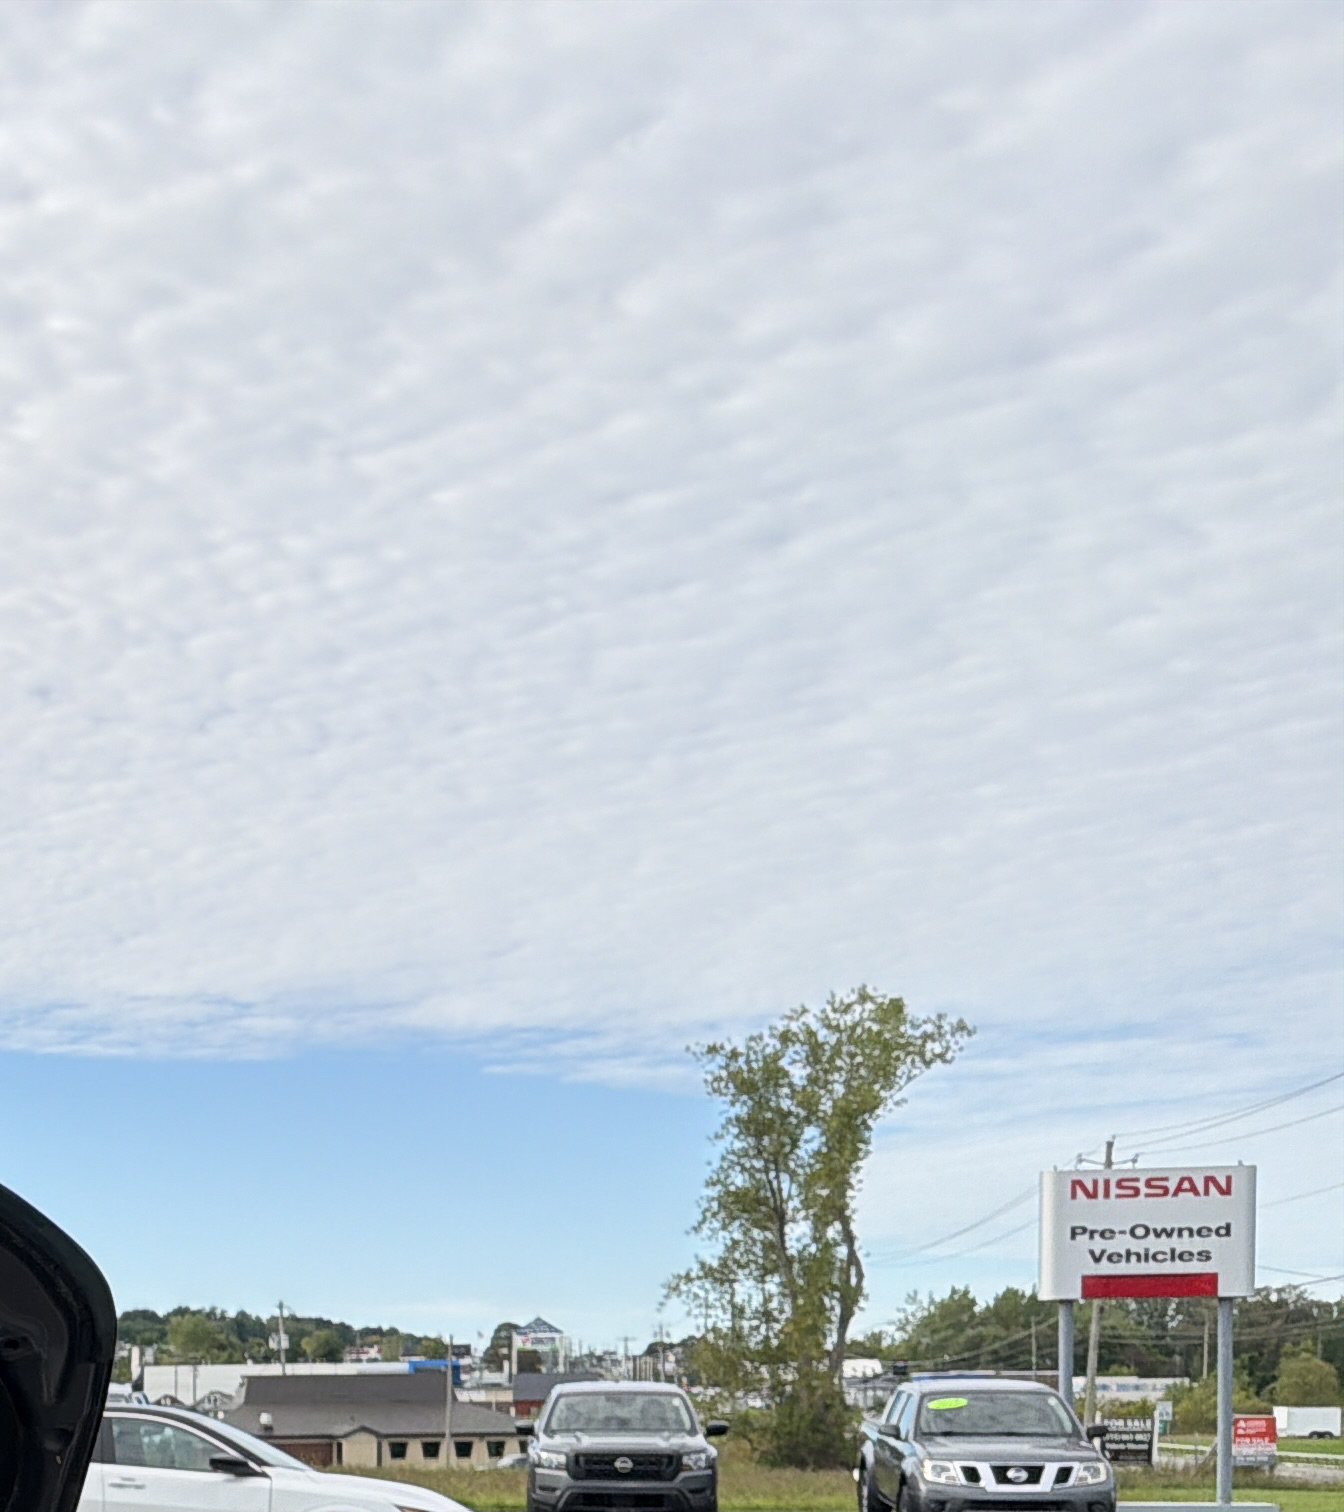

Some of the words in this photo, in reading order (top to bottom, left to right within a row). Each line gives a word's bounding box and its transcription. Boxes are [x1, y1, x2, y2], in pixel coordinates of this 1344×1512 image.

[1070, 1175, 1233, 1200] NISSAN
[1070, 1222, 1232, 1241] Pre-Owned
[1088, 1247, 1213, 1265] Vehicles
